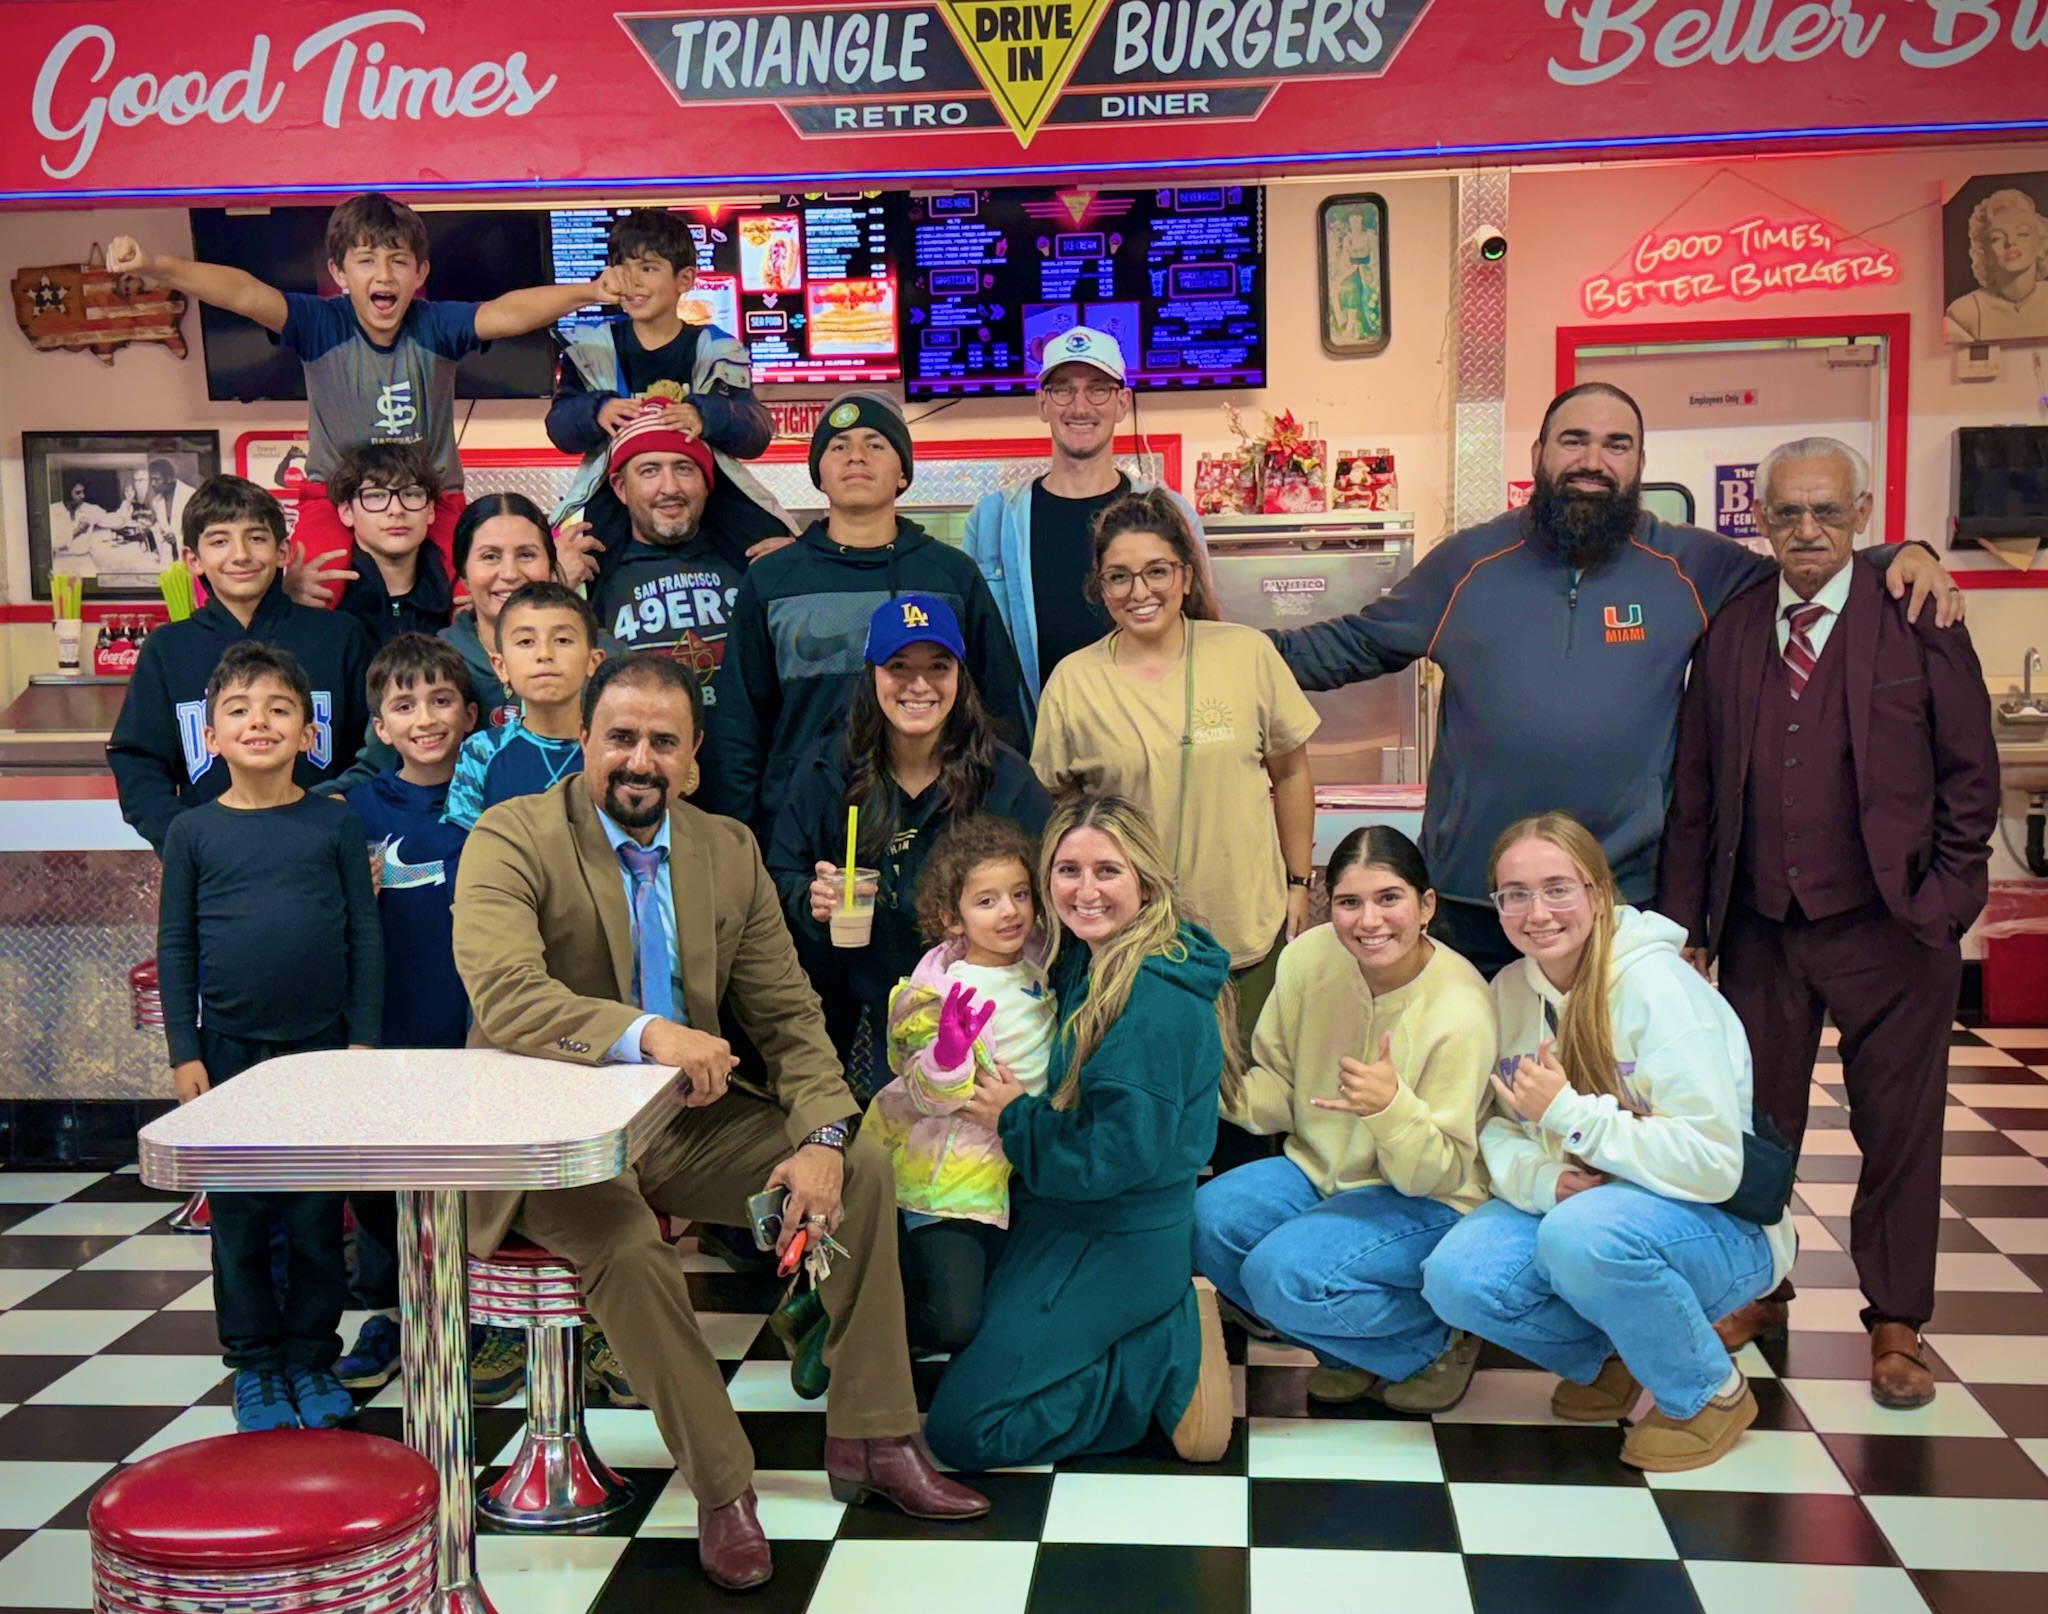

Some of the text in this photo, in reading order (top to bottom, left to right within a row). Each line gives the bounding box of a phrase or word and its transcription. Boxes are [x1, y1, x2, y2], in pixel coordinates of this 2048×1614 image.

[976, 3, 1073, 42] DRIVE
[672, 0, 1385, 90] TRIANGLE BURGERS
[1007, 46, 1043, 82] IN
[32, 9, 557, 179] Good Times
[835, 93, 1210, 128] RETRO DINER
[1635, 219, 1831, 274] GOOD TIMES,
[1584, 253, 1895, 312] BETTER BURGERS
[1690, 394, 1739, 406] Employees Only
[1734, 468, 1756, 480] The
[1719, 514, 1731, 526] OF
[634, 572, 721, 600] SAN FRANCISCO
[901, 602, 929, 628] LA
[1604, 604, 1642, 628] U
[1605, 627, 1645, 643] MIAMI
[886, 840, 910, 857] HAN
